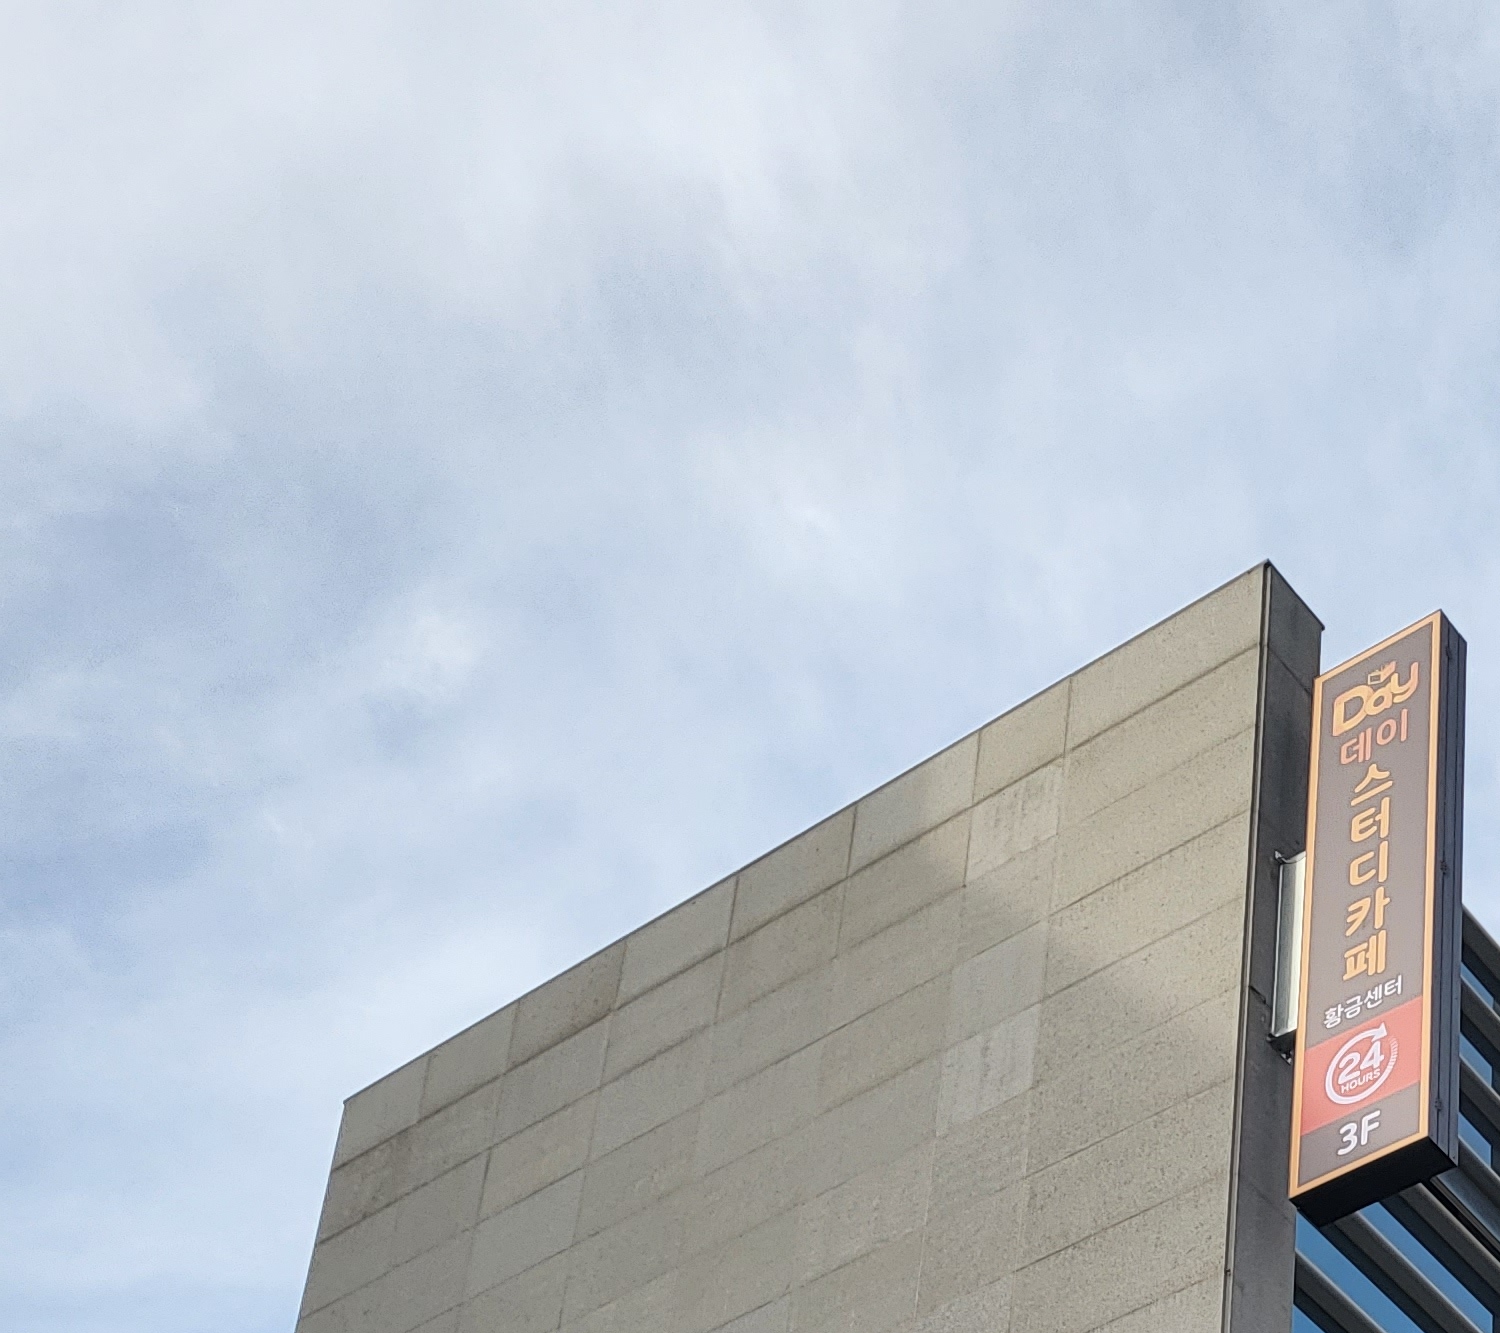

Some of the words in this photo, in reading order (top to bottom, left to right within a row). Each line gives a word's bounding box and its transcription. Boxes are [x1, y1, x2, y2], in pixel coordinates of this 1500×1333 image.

[1332, 662, 1419, 737] Day
[1323, 975, 1403, 1028] 황금센터
[1338, 1040, 1385, 1085] 24
[1341, 1068, 1381, 1094] HOURS
[1337, 1110, 1381, 1156] 3F
